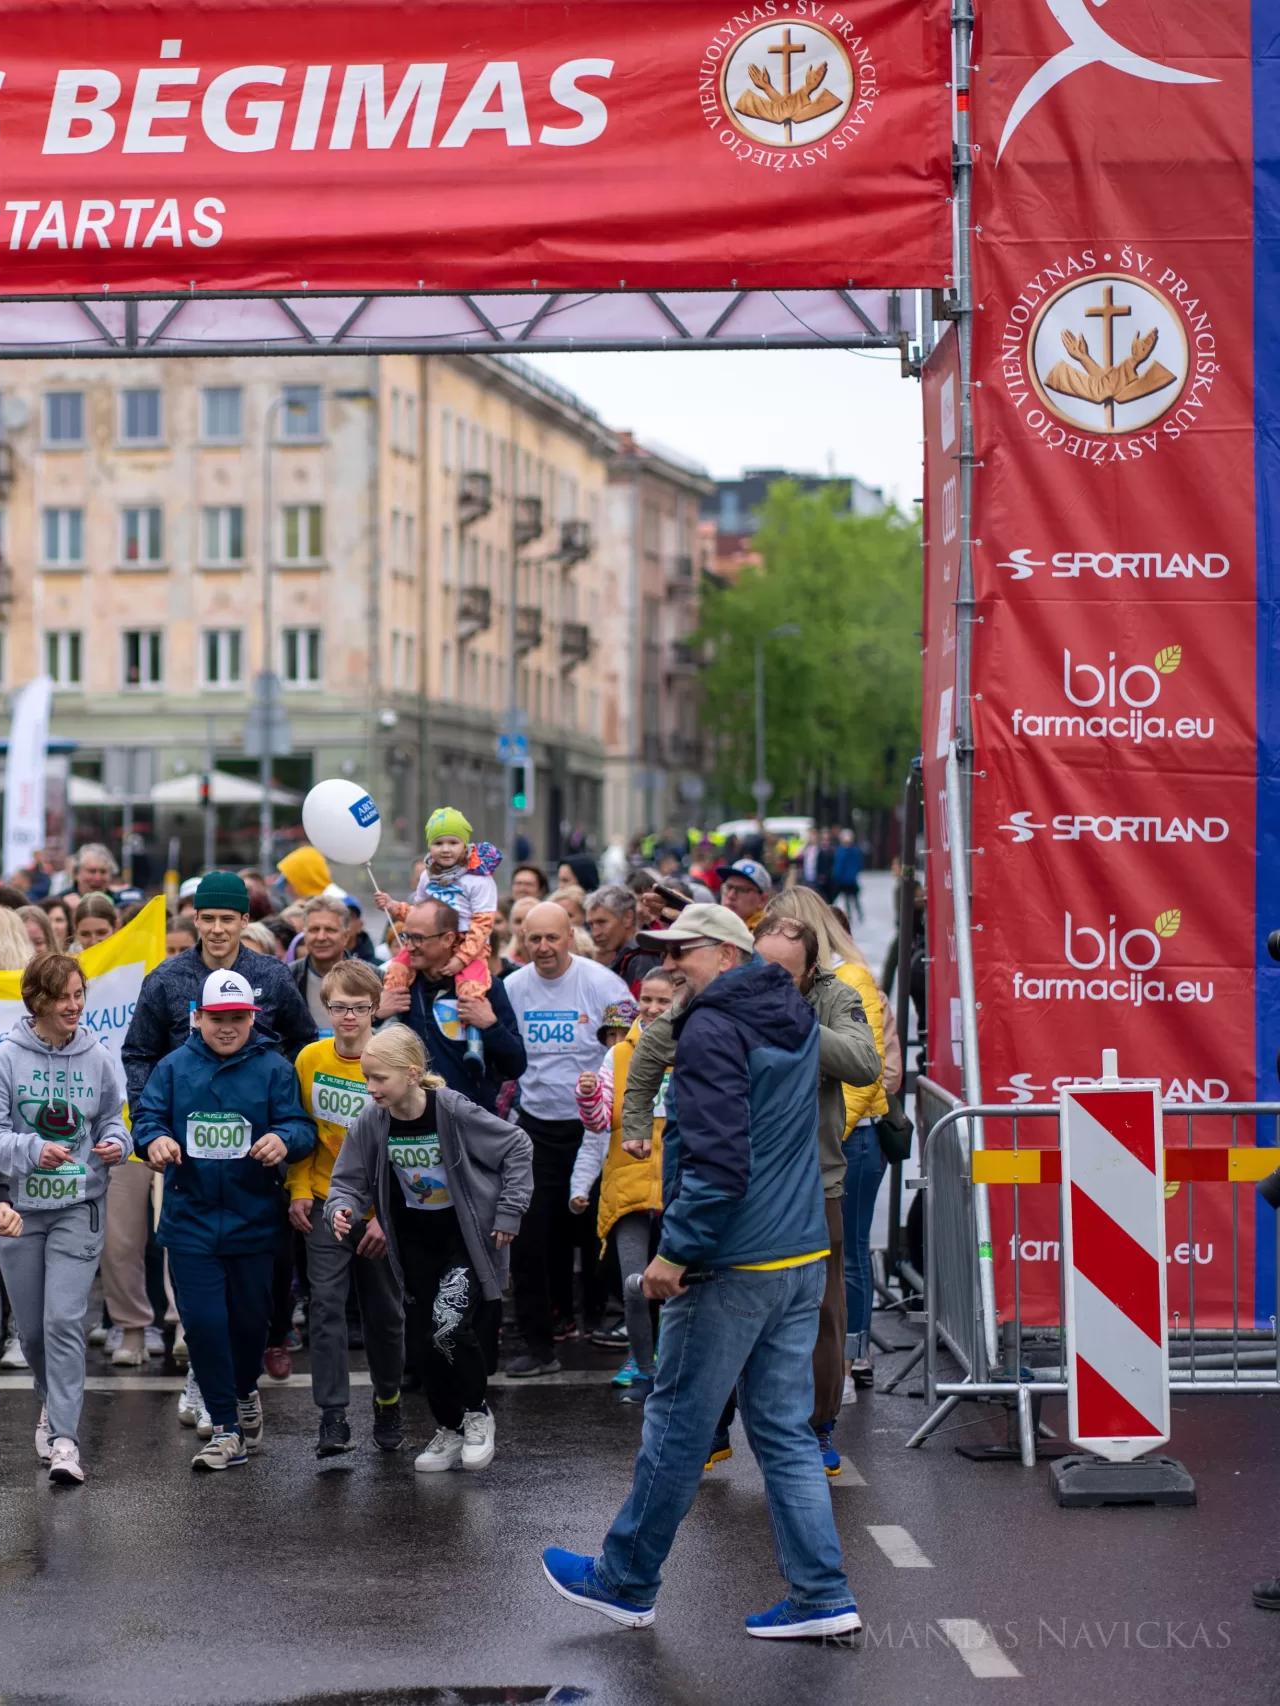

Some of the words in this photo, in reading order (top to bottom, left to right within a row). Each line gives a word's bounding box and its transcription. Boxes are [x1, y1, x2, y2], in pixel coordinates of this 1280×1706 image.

[699, 1, 777, 130] VIENUOLYNAS
[828, 12, 880, 150] PRANCIŠKAUS
[41, 39, 614, 155] BĖGIMAS
[719, 129, 828, 172] ASYŽIEČIO
[1120, 245, 1153, 277] ŠV.
[1001, 250, 1097, 408] VIENUOLYNAS
[1157, 268, 1220, 440] PRANCIŠKAUS
[1026, 409, 1158, 465] ASYŽIEČIO
[1051, 552, 1230, 578] SPORTLAND
[1064, 648, 1161, 708] bio
[1011, 708, 1215, 743] farmacija.eu
[1051, 815, 1230, 842] SPORTLAND
[1065, 911, 1161, 971] bio
[1013, 972, 1214, 1007] farmacija.eu
[527, 1023, 575, 1043] 5048
[345, 1081, 367, 1089] BĖGIMA
[318, 1088, 365, 1118] 6092
[194, 1125, 245, 1149] 6090
[391, 1147, 441, 1168] 6093
[25, 1176, 79, 1200] 6094
